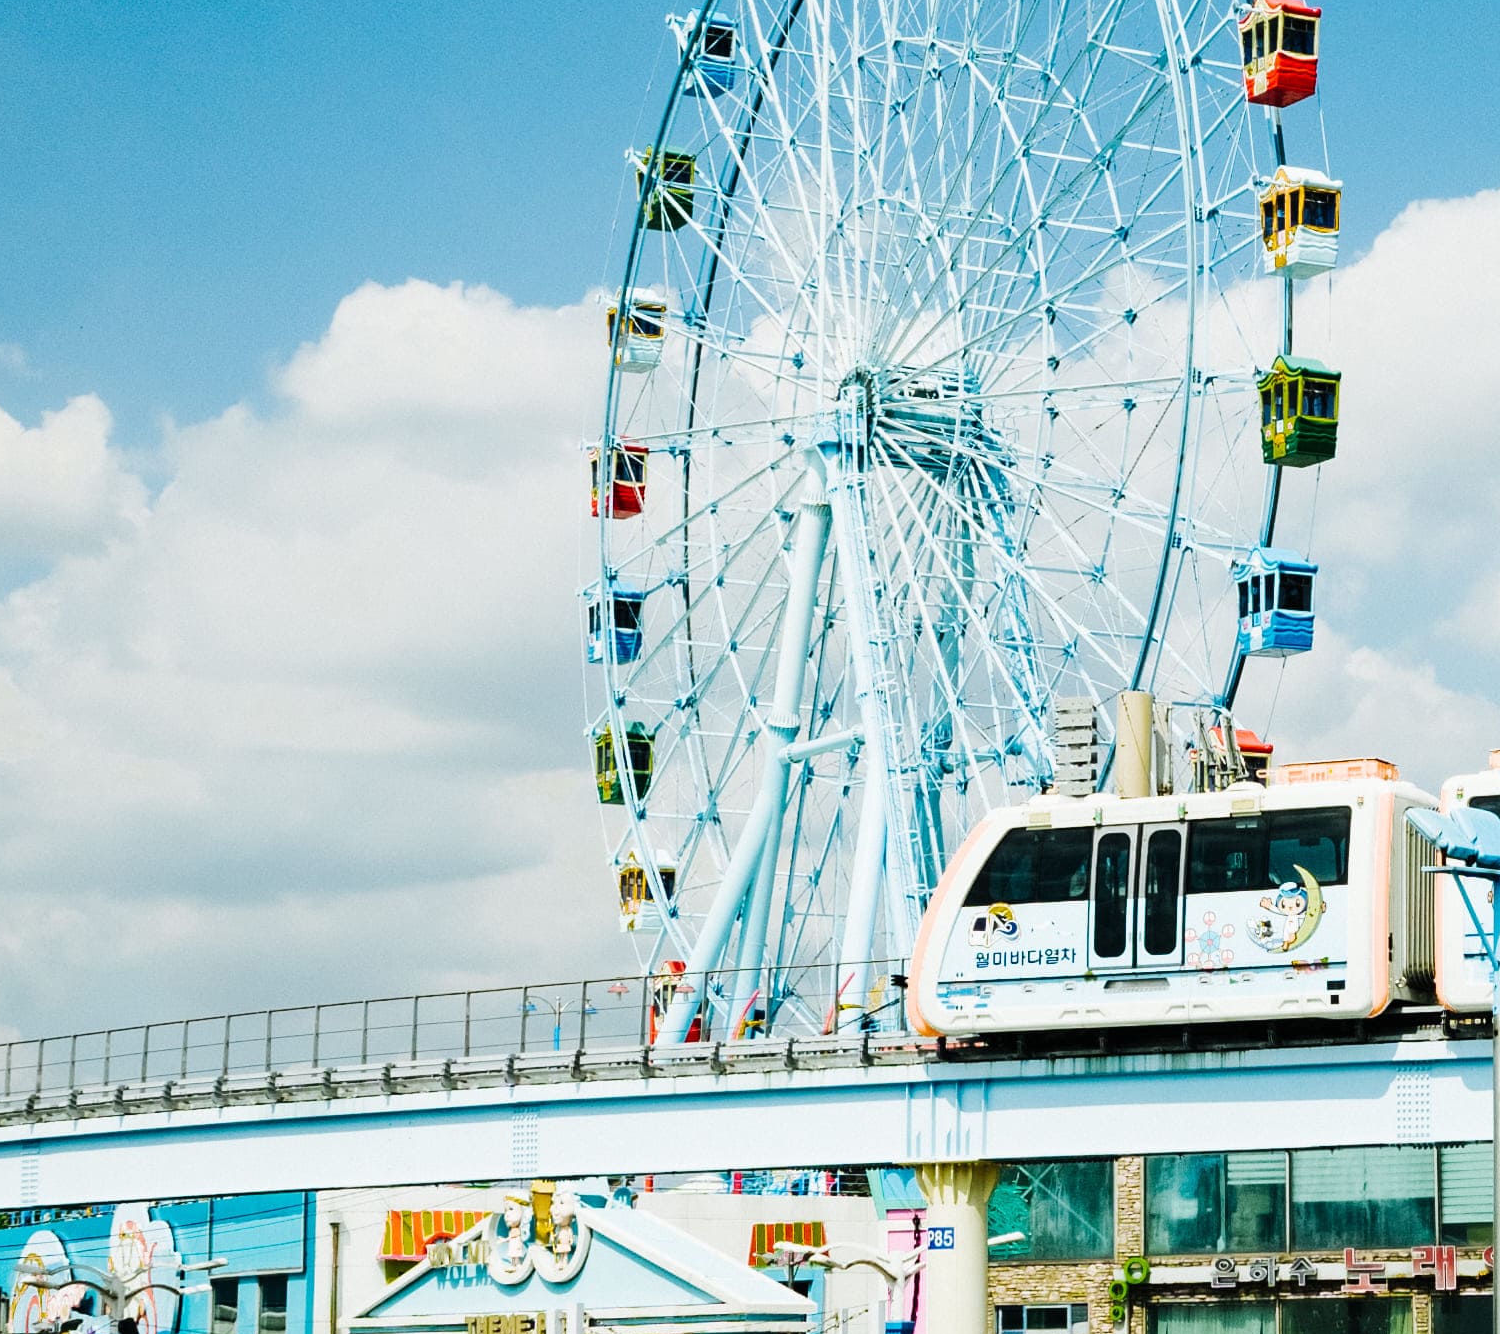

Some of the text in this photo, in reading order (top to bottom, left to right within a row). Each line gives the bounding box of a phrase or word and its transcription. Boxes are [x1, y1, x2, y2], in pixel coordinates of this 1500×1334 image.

[975, 947, 1077, 968] 월미바다열차
[928, 1229, 954, 1248] P85
[1211, 1257, 1317, 1289] 은하수
